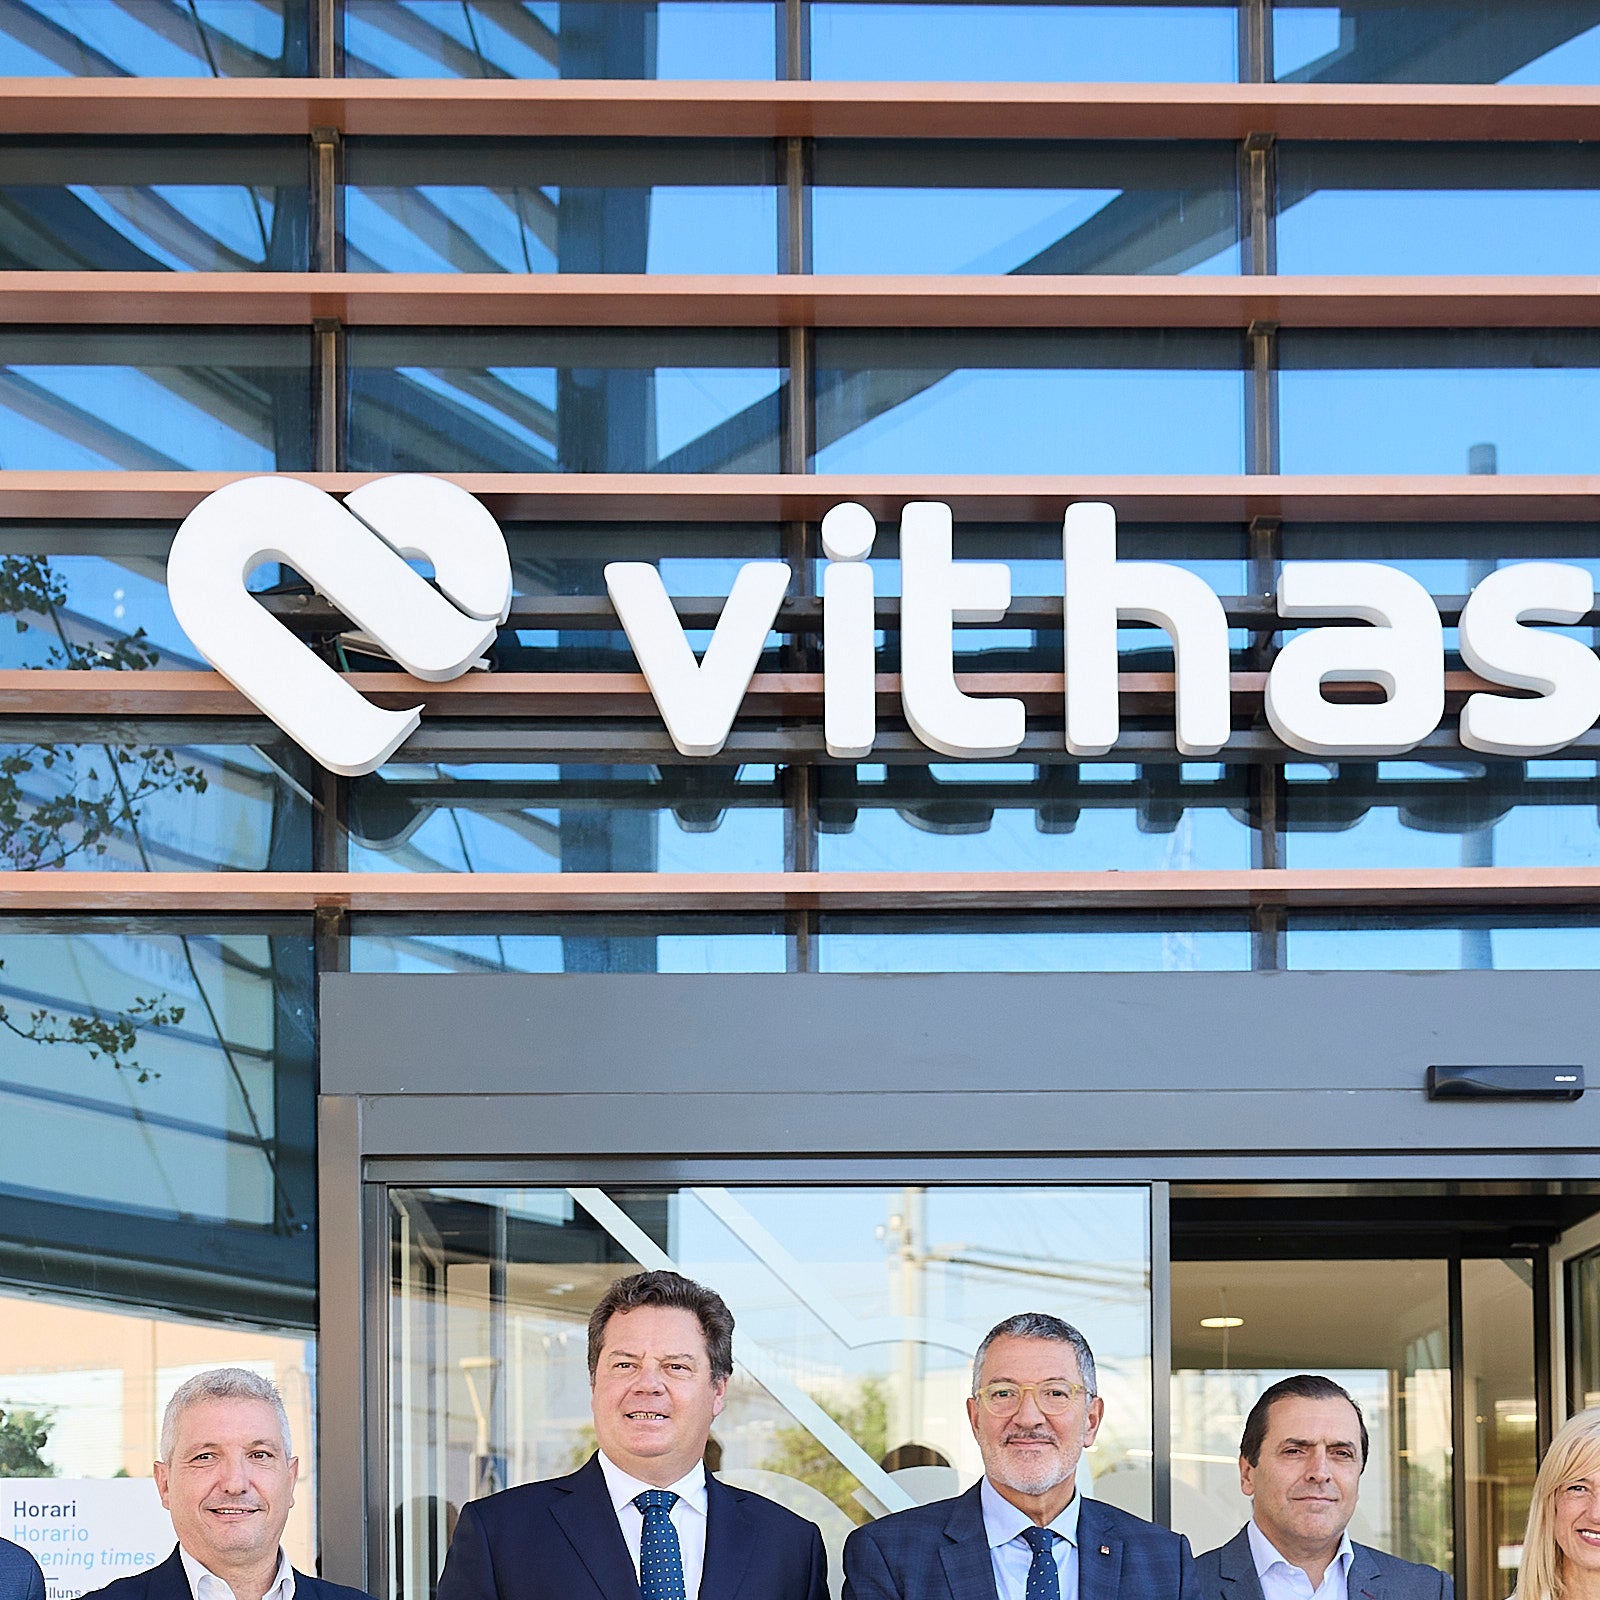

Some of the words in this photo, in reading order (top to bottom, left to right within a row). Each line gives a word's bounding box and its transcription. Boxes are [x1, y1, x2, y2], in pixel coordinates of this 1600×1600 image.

[13, 1501, 76, 1517] Horari
[13, 1524, 89, 1542] Horario
[34, 1548, 94, 1570] ening
[101, 1548, 156, 1565] times
[48, 1586, 81, 1598] lluns
